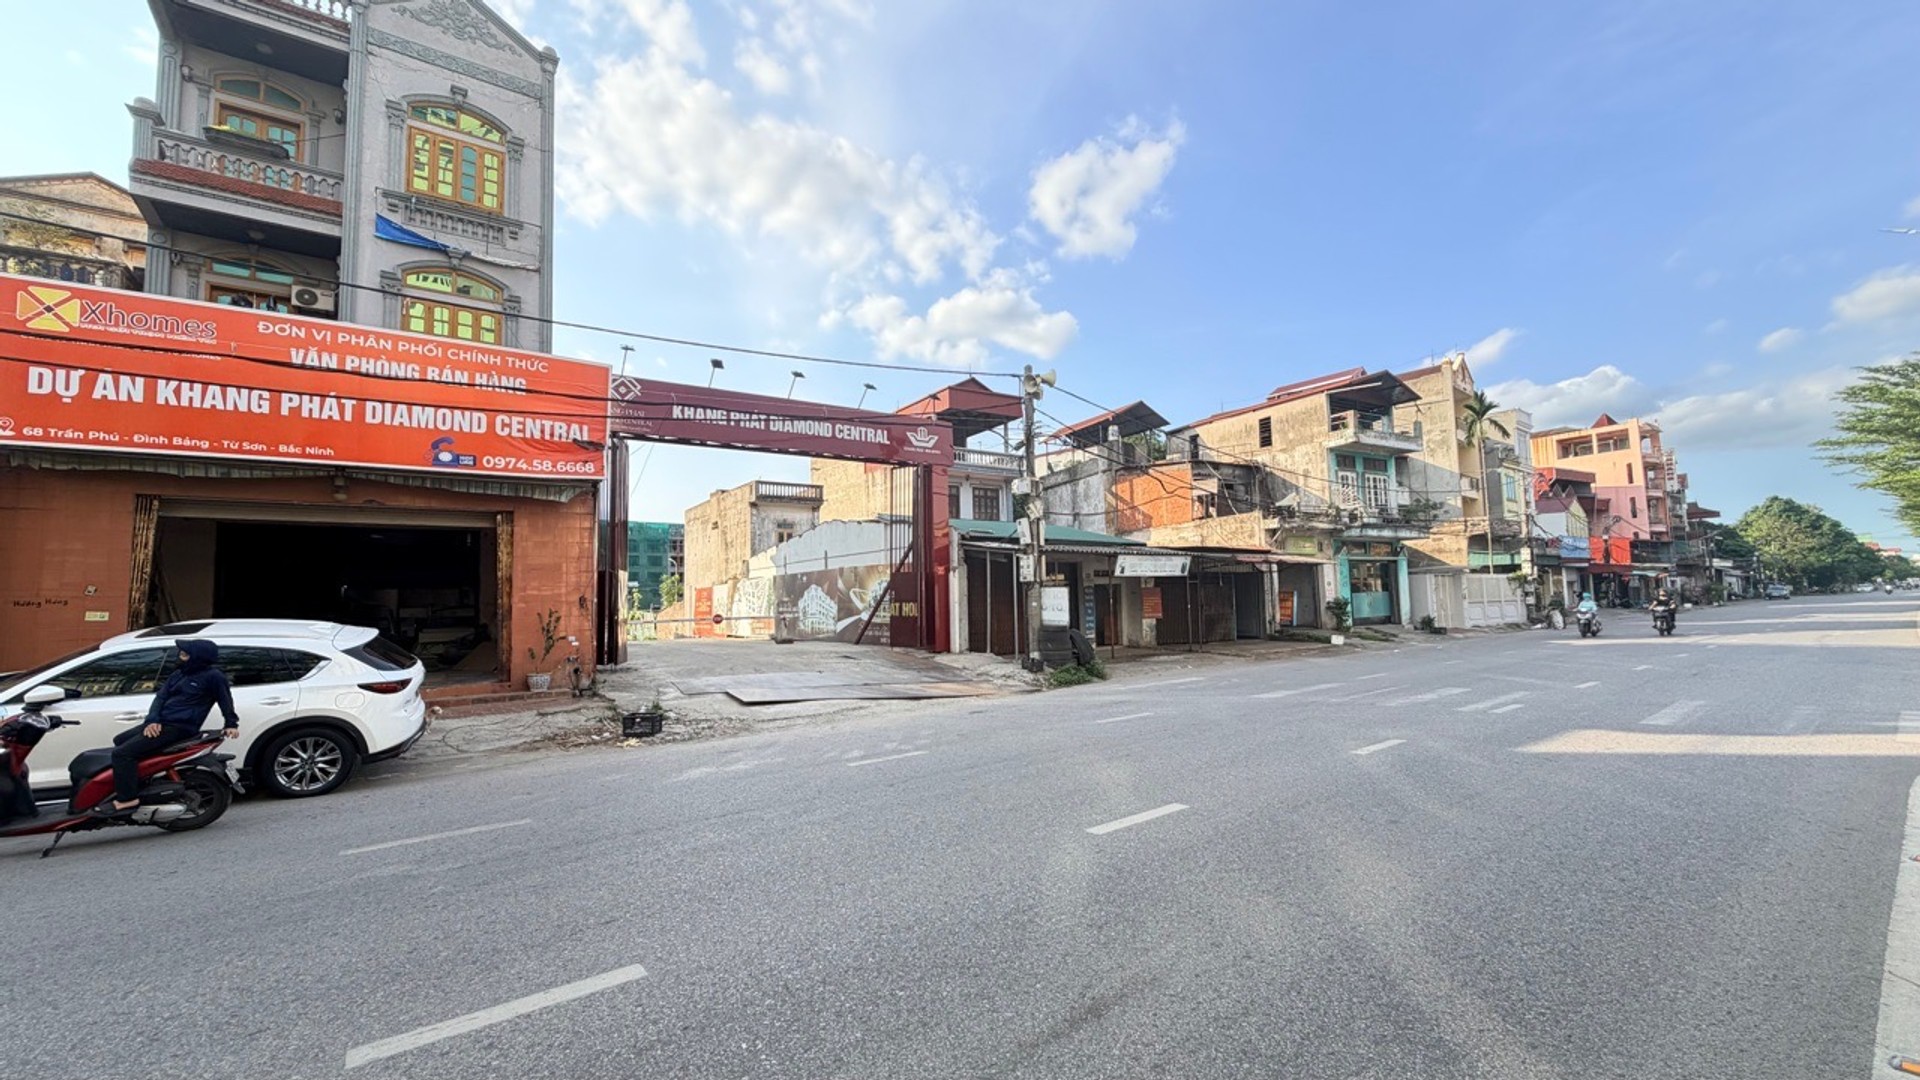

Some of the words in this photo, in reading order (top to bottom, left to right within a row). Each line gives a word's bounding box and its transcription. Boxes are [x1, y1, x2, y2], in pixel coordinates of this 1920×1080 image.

[81, 299, 217, 339] Xhomes
[257, 321, 306, 338] ĐƠN
[311, 328, 331, 345] VỊ
[337, 332, 392, 351] PHÂN
[398, 340, 442, 357] PHỐI
[447, 347, 501, 366] CHÍNH
[505, 356, 549, 373] THỨC
[290, 346, 338, 369] VĂN
[344, 354, 420, 379] PHÒNG
[427, 364, 468, 388] BÁN
[474, 370, 527, 395] HÀNG
[27, 366, 85, 403] DỰ
[91, 368, 145, 403] ÁN
[156, 378, 270, 415] KHANG
[280, 392, 357, 422] PHÁT
[365, 401, 487, 434] DIAMOND
[495, 414, 589, 442] CENTRAL
[672, 404, 728, 425] KHANG
[769, 415, 833, 438] DIAMOND
[835, 424, 890, 444] CENTRAL
[22, 426, 44, 437] 68
[305, 446, 334, 456] Ninh
[482, 455, 595, 473] 0974.58.6668
